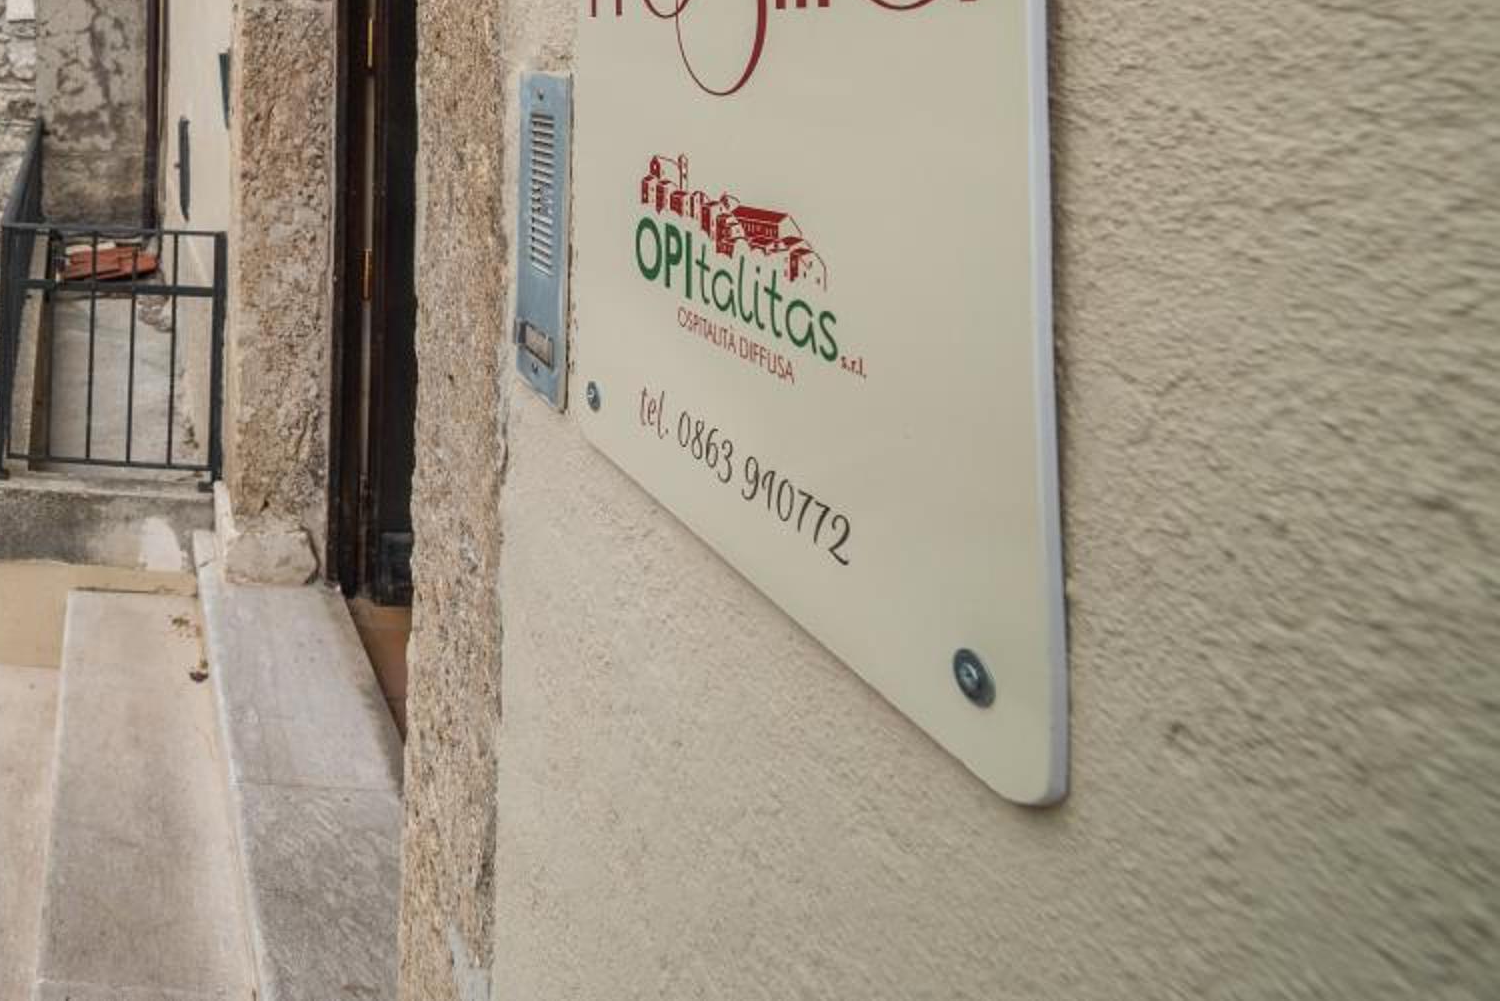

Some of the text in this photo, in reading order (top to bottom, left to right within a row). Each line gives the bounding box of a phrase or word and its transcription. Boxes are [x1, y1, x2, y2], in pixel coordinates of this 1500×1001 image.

[739, 336, 795, 384] DIFFUSA
[640, 386, 850, 566] tel. 0863 910772
